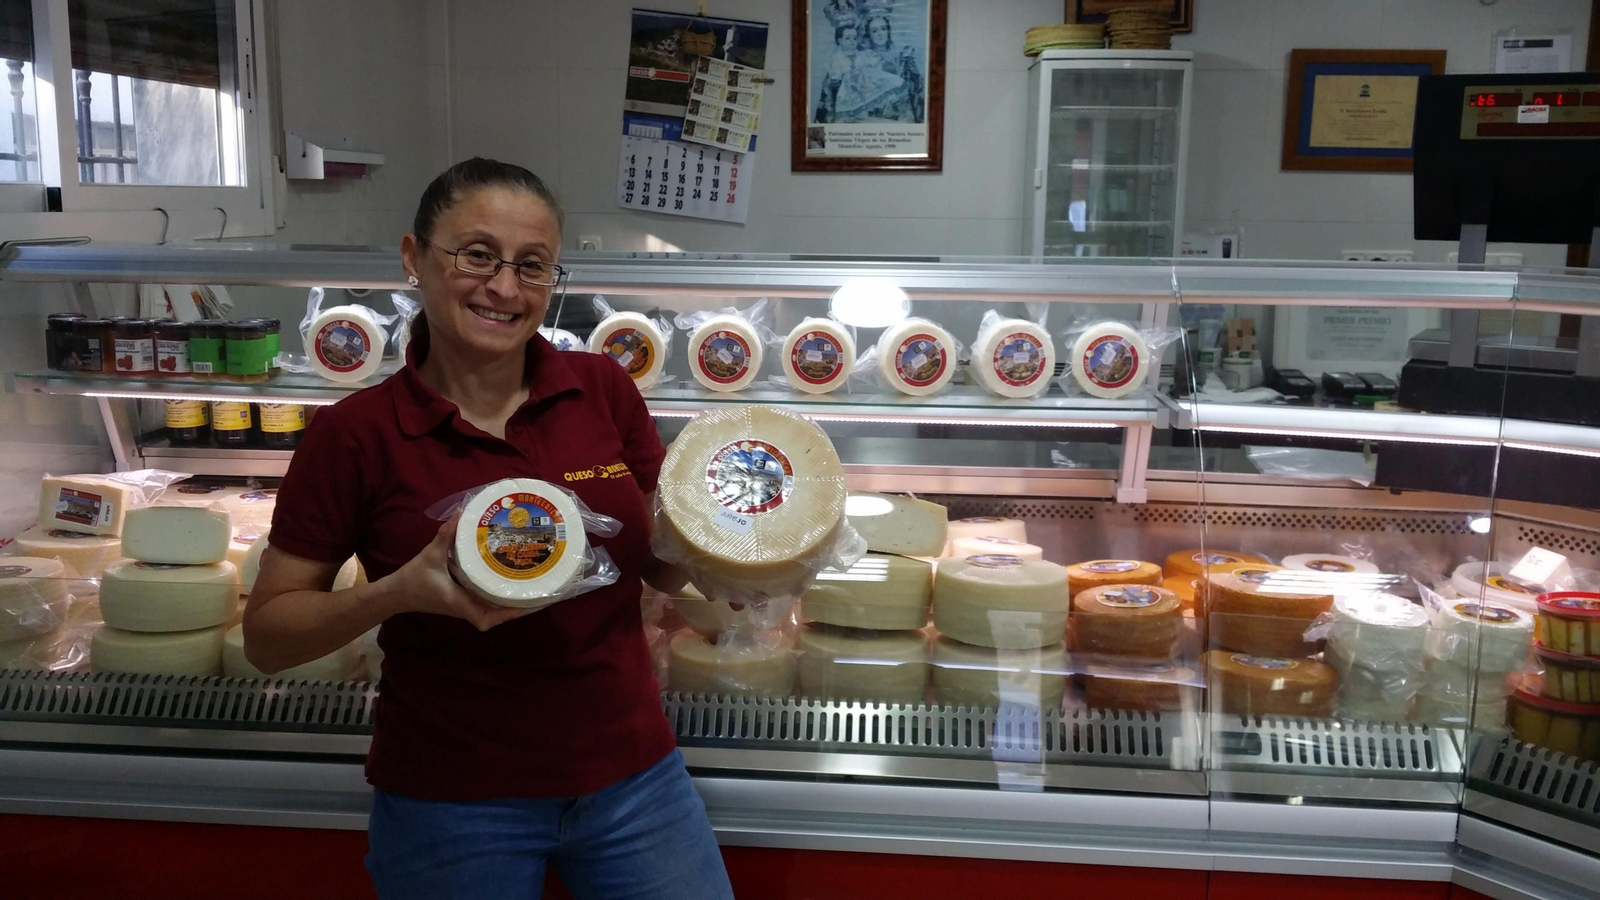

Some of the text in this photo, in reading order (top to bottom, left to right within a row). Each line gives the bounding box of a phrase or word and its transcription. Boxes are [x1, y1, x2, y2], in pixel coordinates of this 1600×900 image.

[666, 146, 738, 164] 1 2 3 4 5
[631, 155, 738, 178] 6 7 8 9 10 11 12
[629, 168, 736, 190] 13 14 15 16 17 18 19
[626, 180, 735, 204] 20 21 22 23 24 25 26
[625, 193, 683, 210] 27 28 29 30
[1324, 316, 1392, 325] PRIMER PREMIO
[564, 470, 594, 482] QUESO
[481, 504, 500, 526] QUESO
[720, 512, 747, 526] AÑEJO
